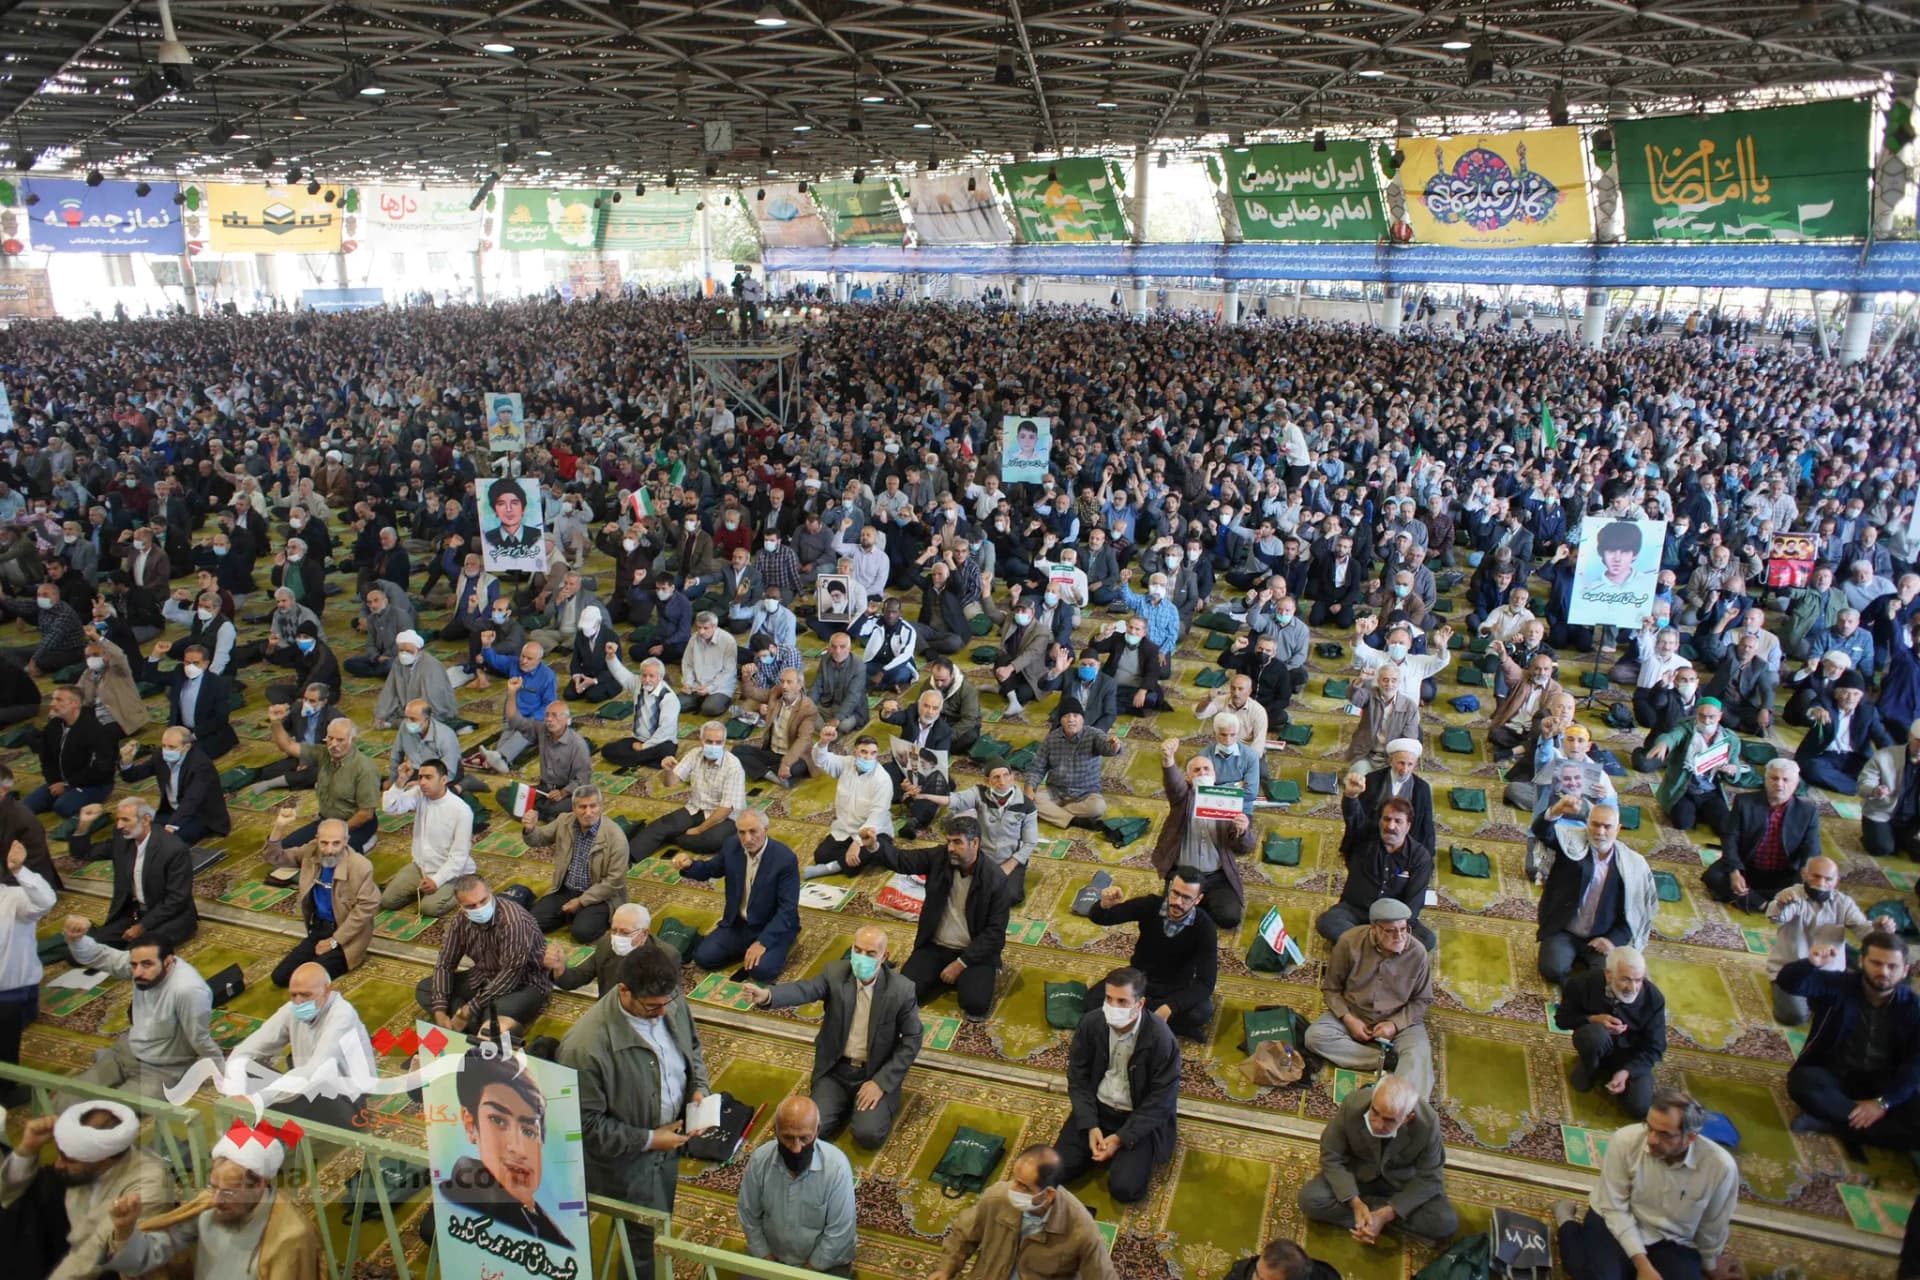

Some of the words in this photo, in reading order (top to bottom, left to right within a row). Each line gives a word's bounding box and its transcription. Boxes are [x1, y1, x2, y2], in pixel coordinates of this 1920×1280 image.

[1238, 164, 1312, 193] سرزمین
[1312, 156, 1365, 190] ایران
[1746, 133, 1771, 204] یا
[1244, 199, 1268, 221] ها
[1427, 180, 1475, 212] جمعه
[1464, 180, 1512, 218] عید
[1500, 179, 1549, 216] نماز
[122, 208, 170, 233] نماز
[1269, 198, 1332, 228] رضایی
[1330, 196, 1373, 230] امام
